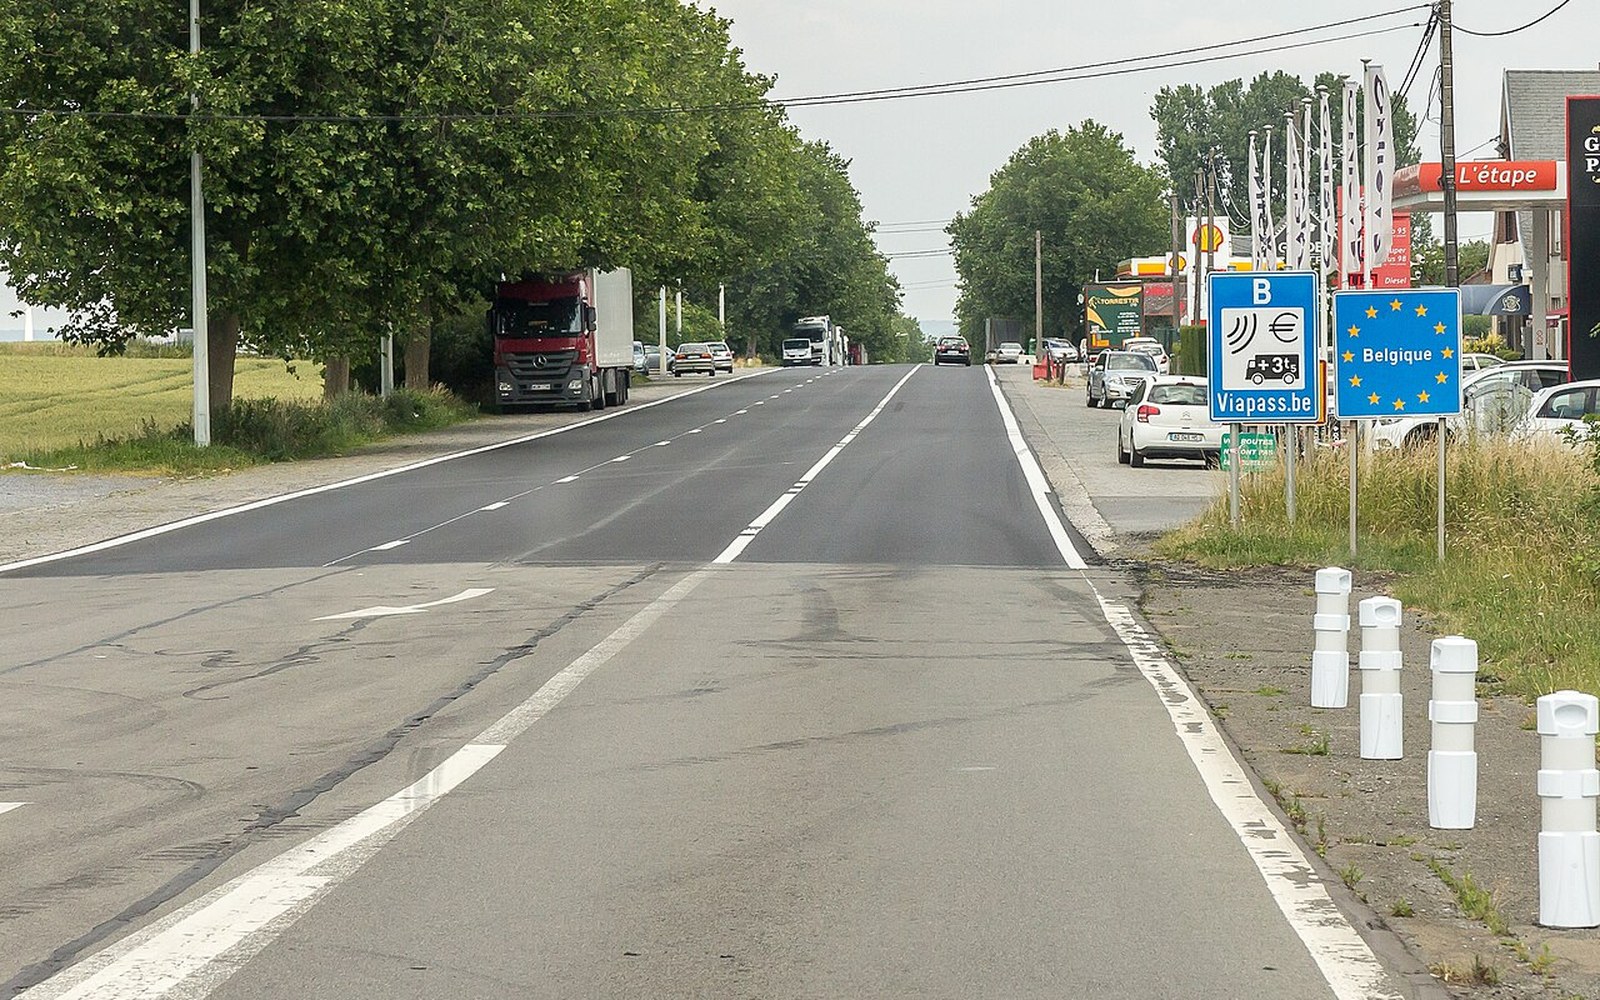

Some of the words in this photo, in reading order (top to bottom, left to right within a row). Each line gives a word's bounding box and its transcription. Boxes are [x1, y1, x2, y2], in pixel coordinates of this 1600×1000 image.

[1460, 164, 1537, 187] L'étape
[1389, 247, 1406, 255] uper
[1384, 277, 1407, 285] Diesel
[1253, 278, 1272, 305] B
[1363, 347, 1432, 365] Belgique
[1216, 392, 1311, 417] Viapass.be
